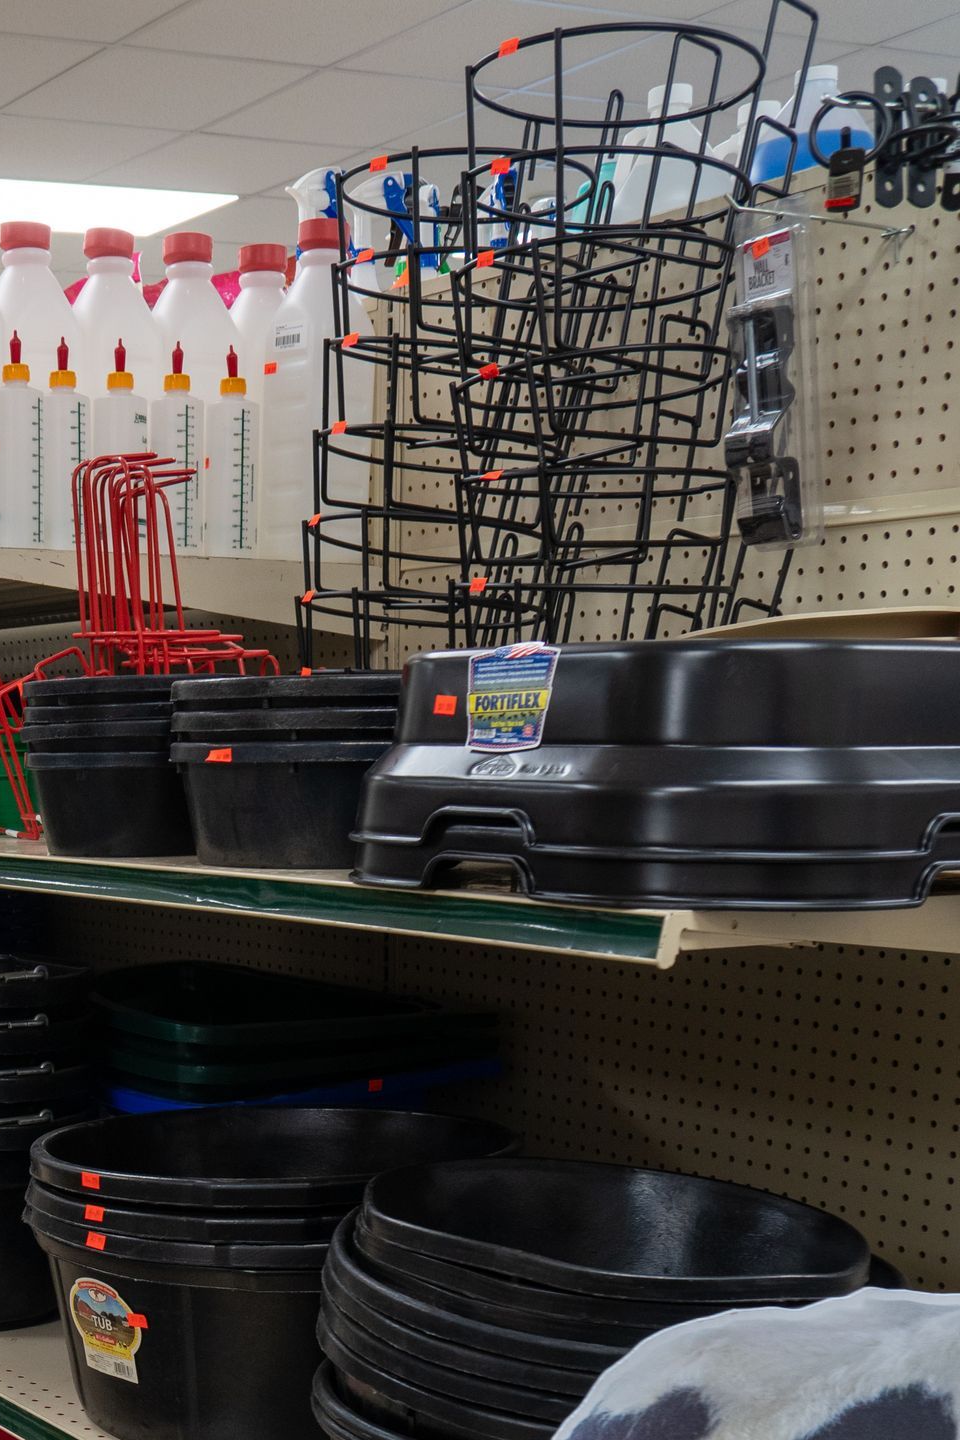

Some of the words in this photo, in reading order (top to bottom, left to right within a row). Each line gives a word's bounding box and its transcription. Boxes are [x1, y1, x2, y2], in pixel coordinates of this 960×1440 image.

[748, 270, 775, 290] BRACKET
[474, 691, 541, 711] FORTIFLEX
[91, 1314, 113, 1331] TUB
